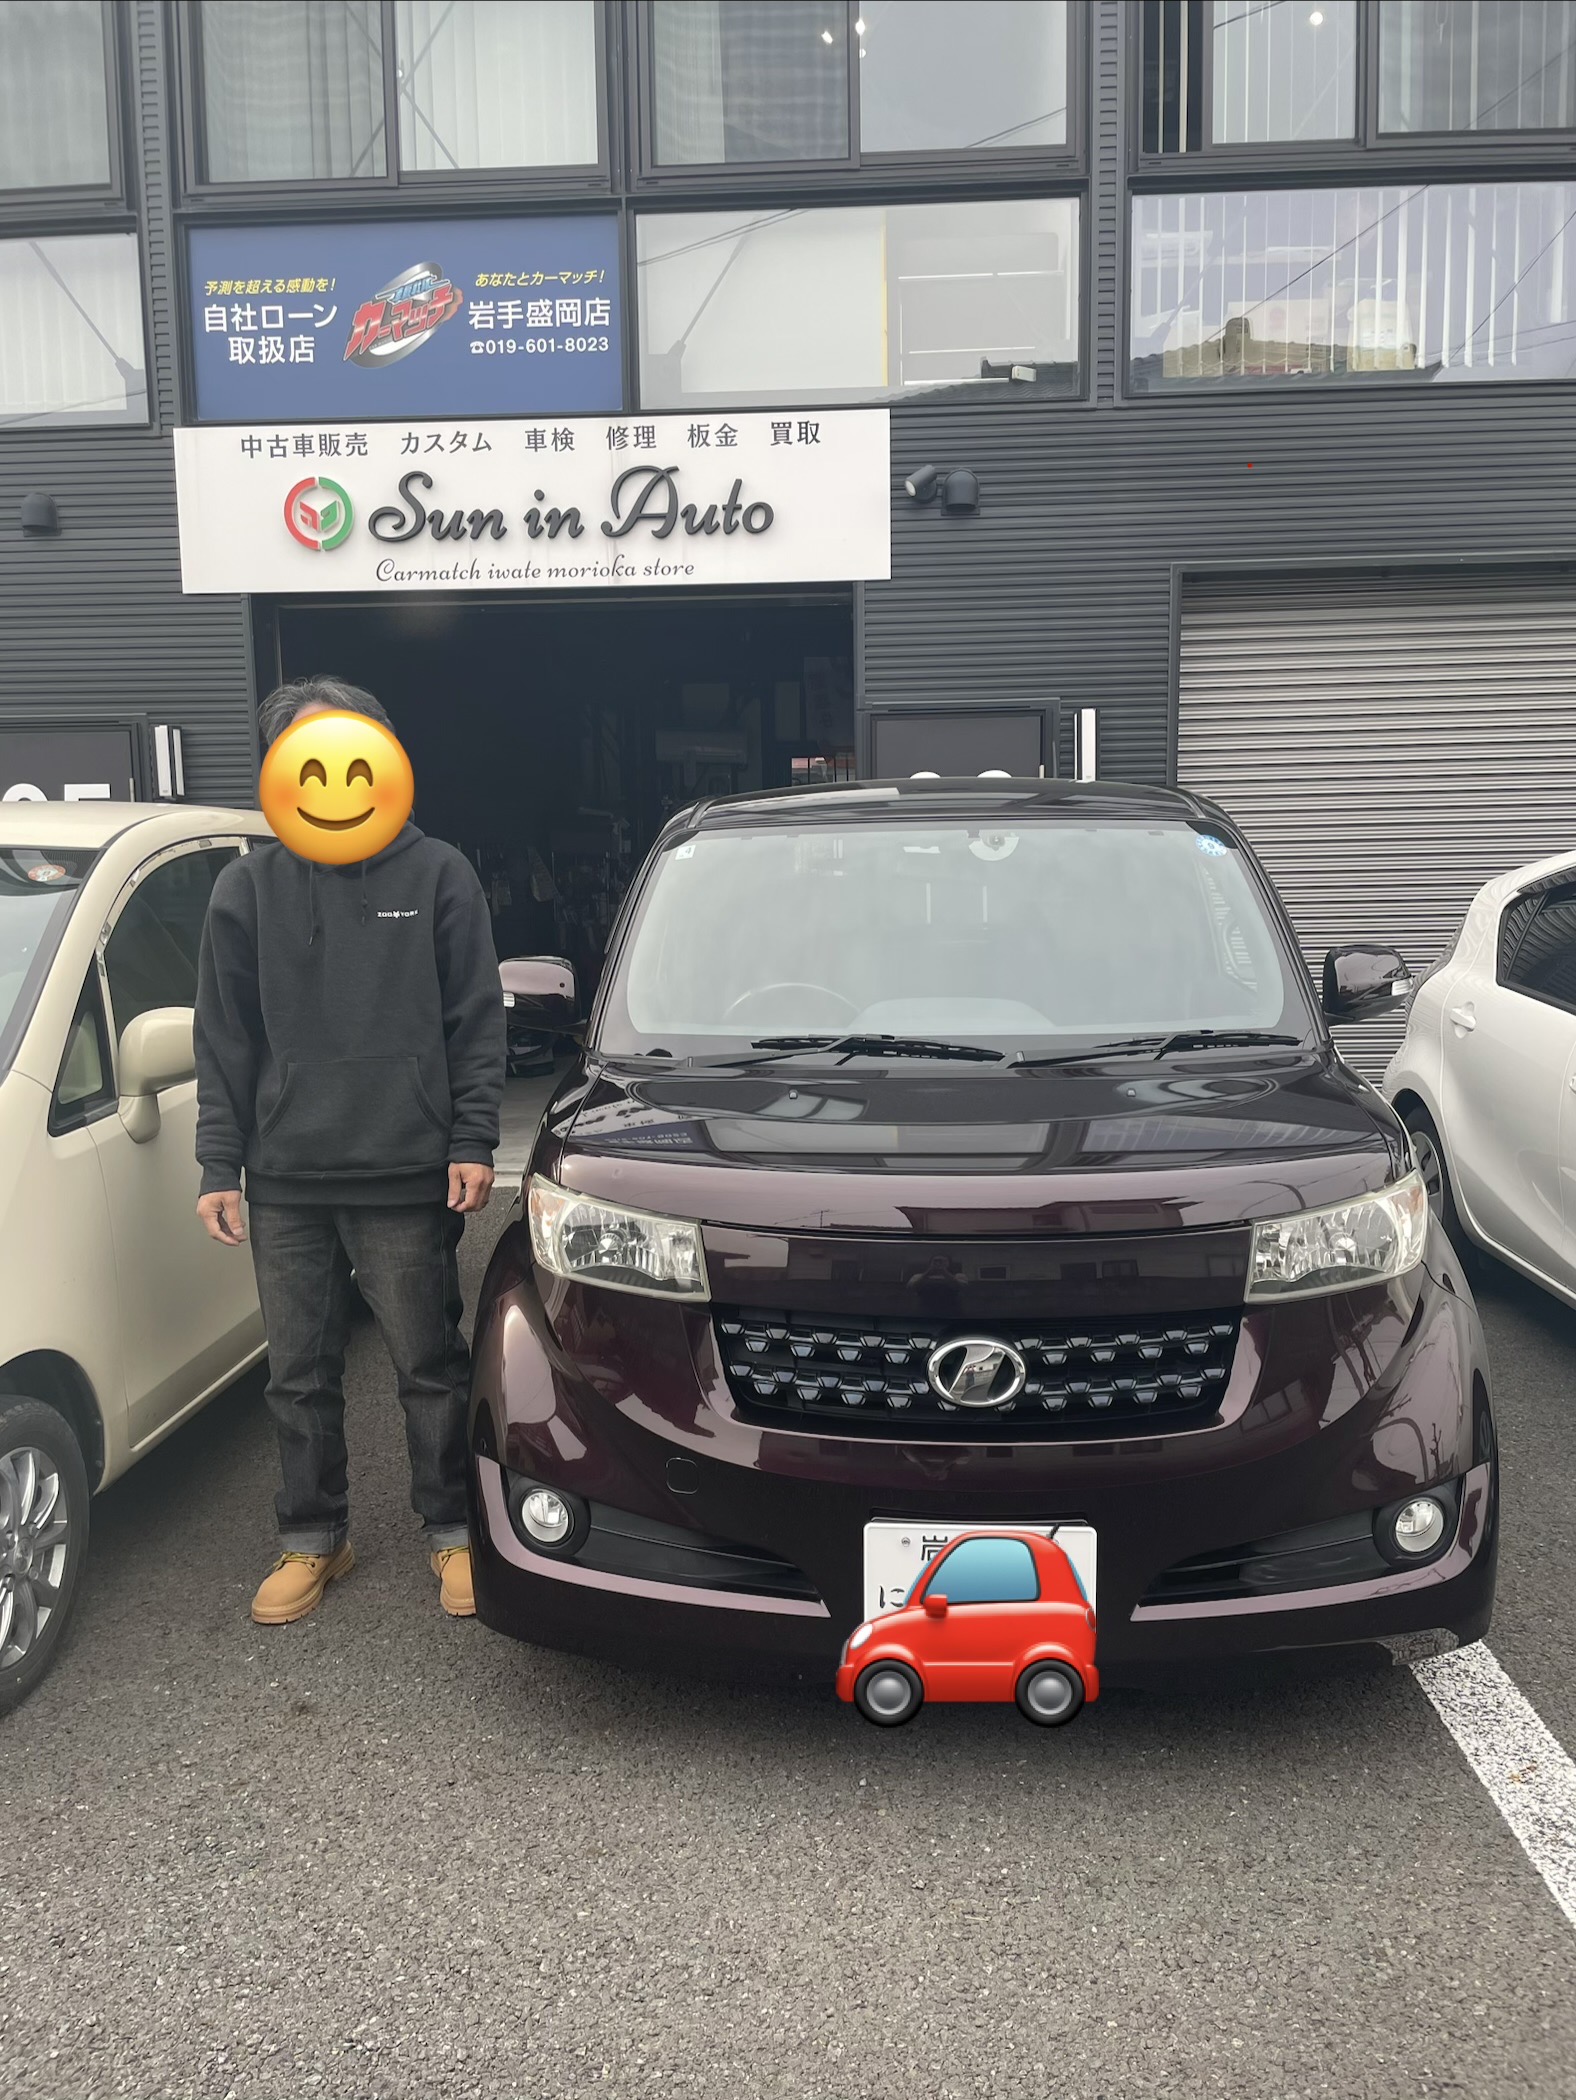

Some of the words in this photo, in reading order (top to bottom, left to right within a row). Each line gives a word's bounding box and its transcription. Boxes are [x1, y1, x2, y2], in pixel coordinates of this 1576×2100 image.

[203, 302, 338, 333] 自社ローン
[343, 283, 454, 361] カーマッチ
[468, 297, 611, 330] 岩手盛岡店
[227, 334, 315, 365] 取扱店
[485, 337, 609, 354] 019-601-8023
[241, 433, 368, 459] 中古車販売
[400, 431, 492, 455] カスタム
[524, 427, 576, 452] 車検
[605, 425, 657, 450] 修理
[687, 423, 739, 448] 板金
[770, 420, 821, 446] 買取
[368, 471, 508, 543] Sun
[523, 489, 585, 539] in
[600, 465, 774, 539] Auto
[376, 558, 482, 582] Carmatch
[487, 563, 541, 580] iwate
[547, 554, 637, 578] morioka
[643, 558, 695, 576] store
